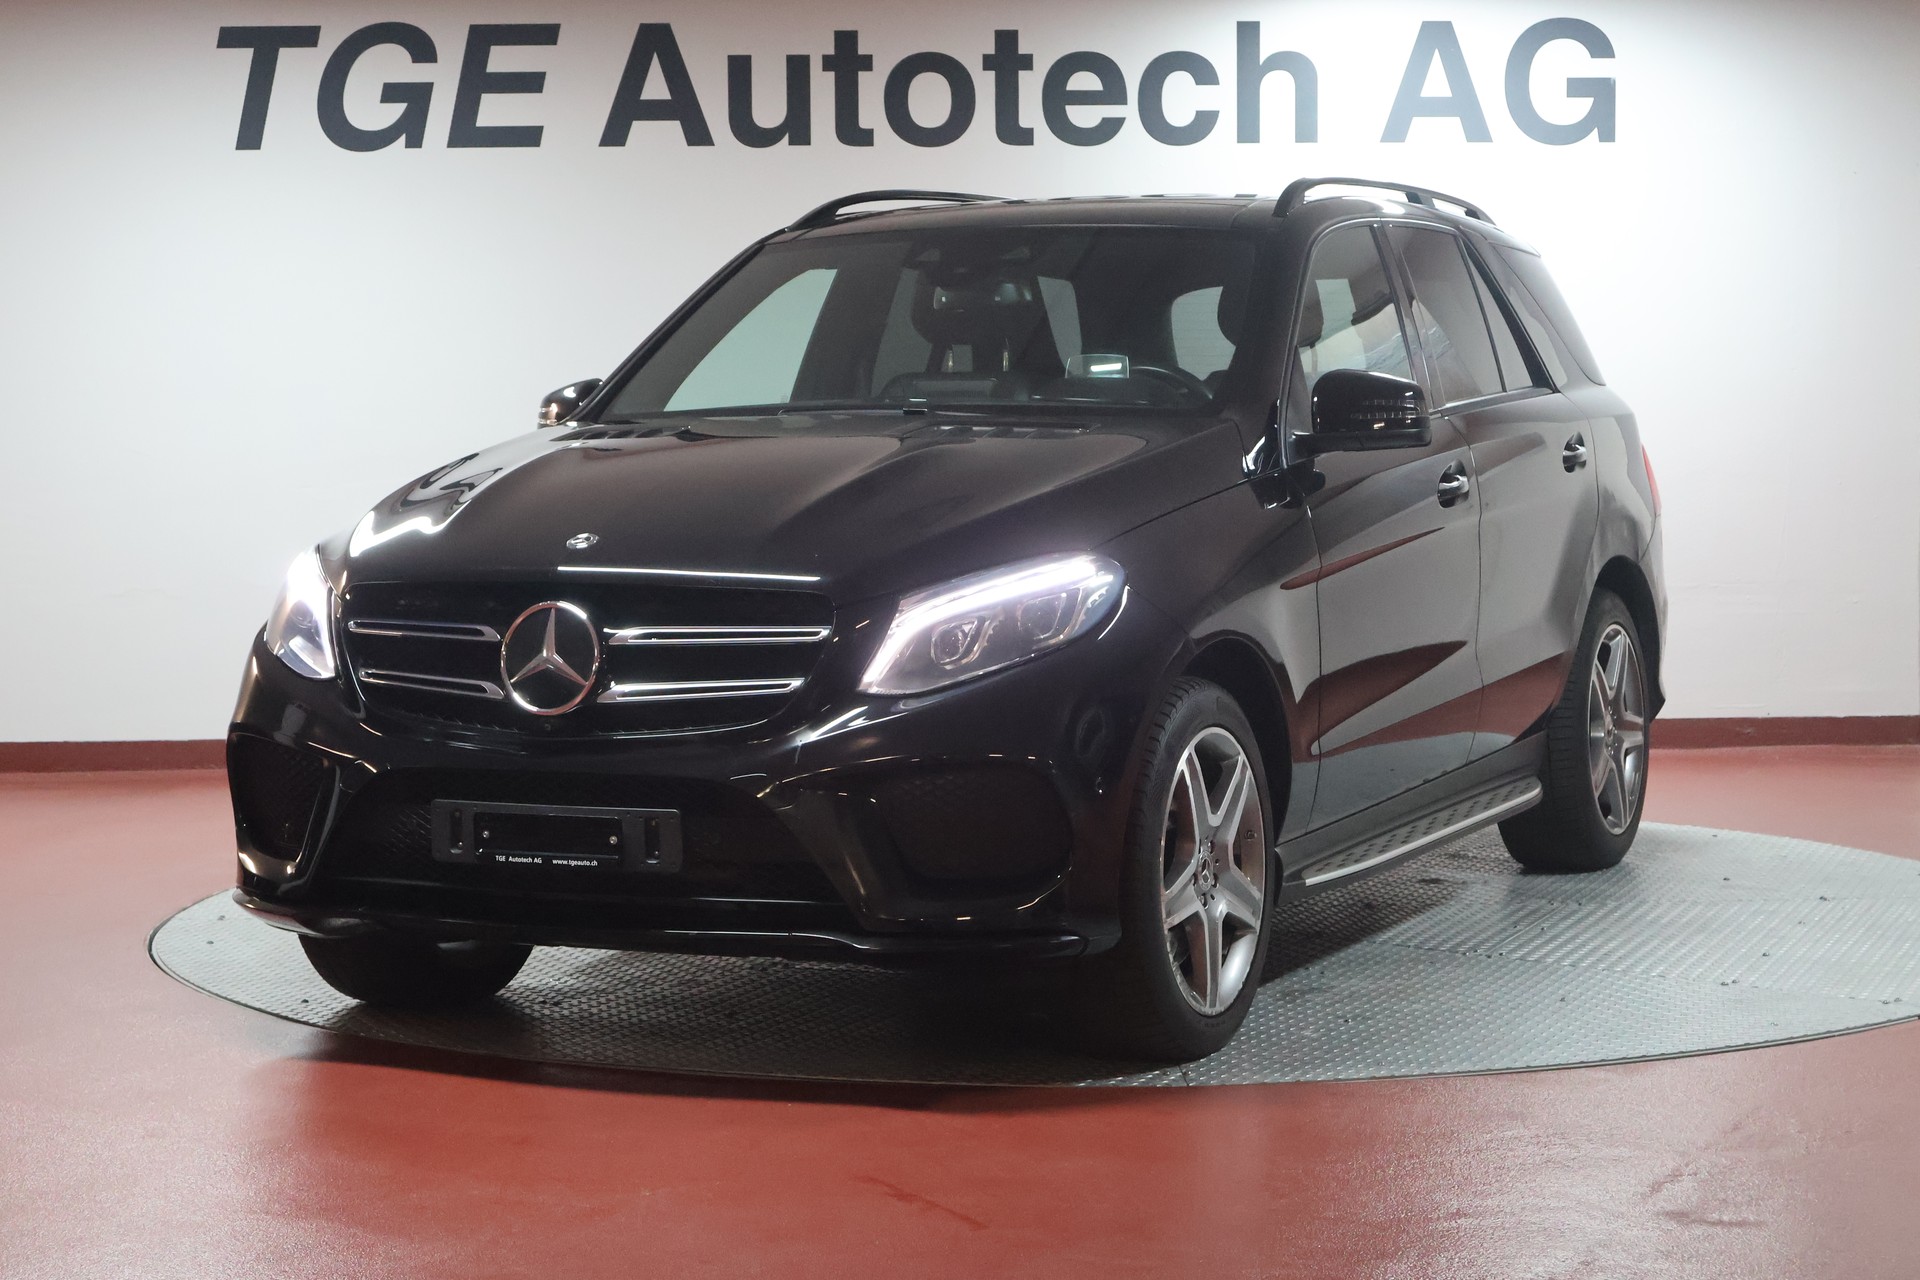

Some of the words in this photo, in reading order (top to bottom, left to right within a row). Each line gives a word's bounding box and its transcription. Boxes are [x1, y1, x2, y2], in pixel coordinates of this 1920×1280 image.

[216, 21, 562, 153] TGE
[598, 21, 1319, 148] Autotech
[1379, 17, 1617, 147] AG
[508, 855, 533, 863] Autotech
[552, 859, 598, 867] www.tgeauto.ch
